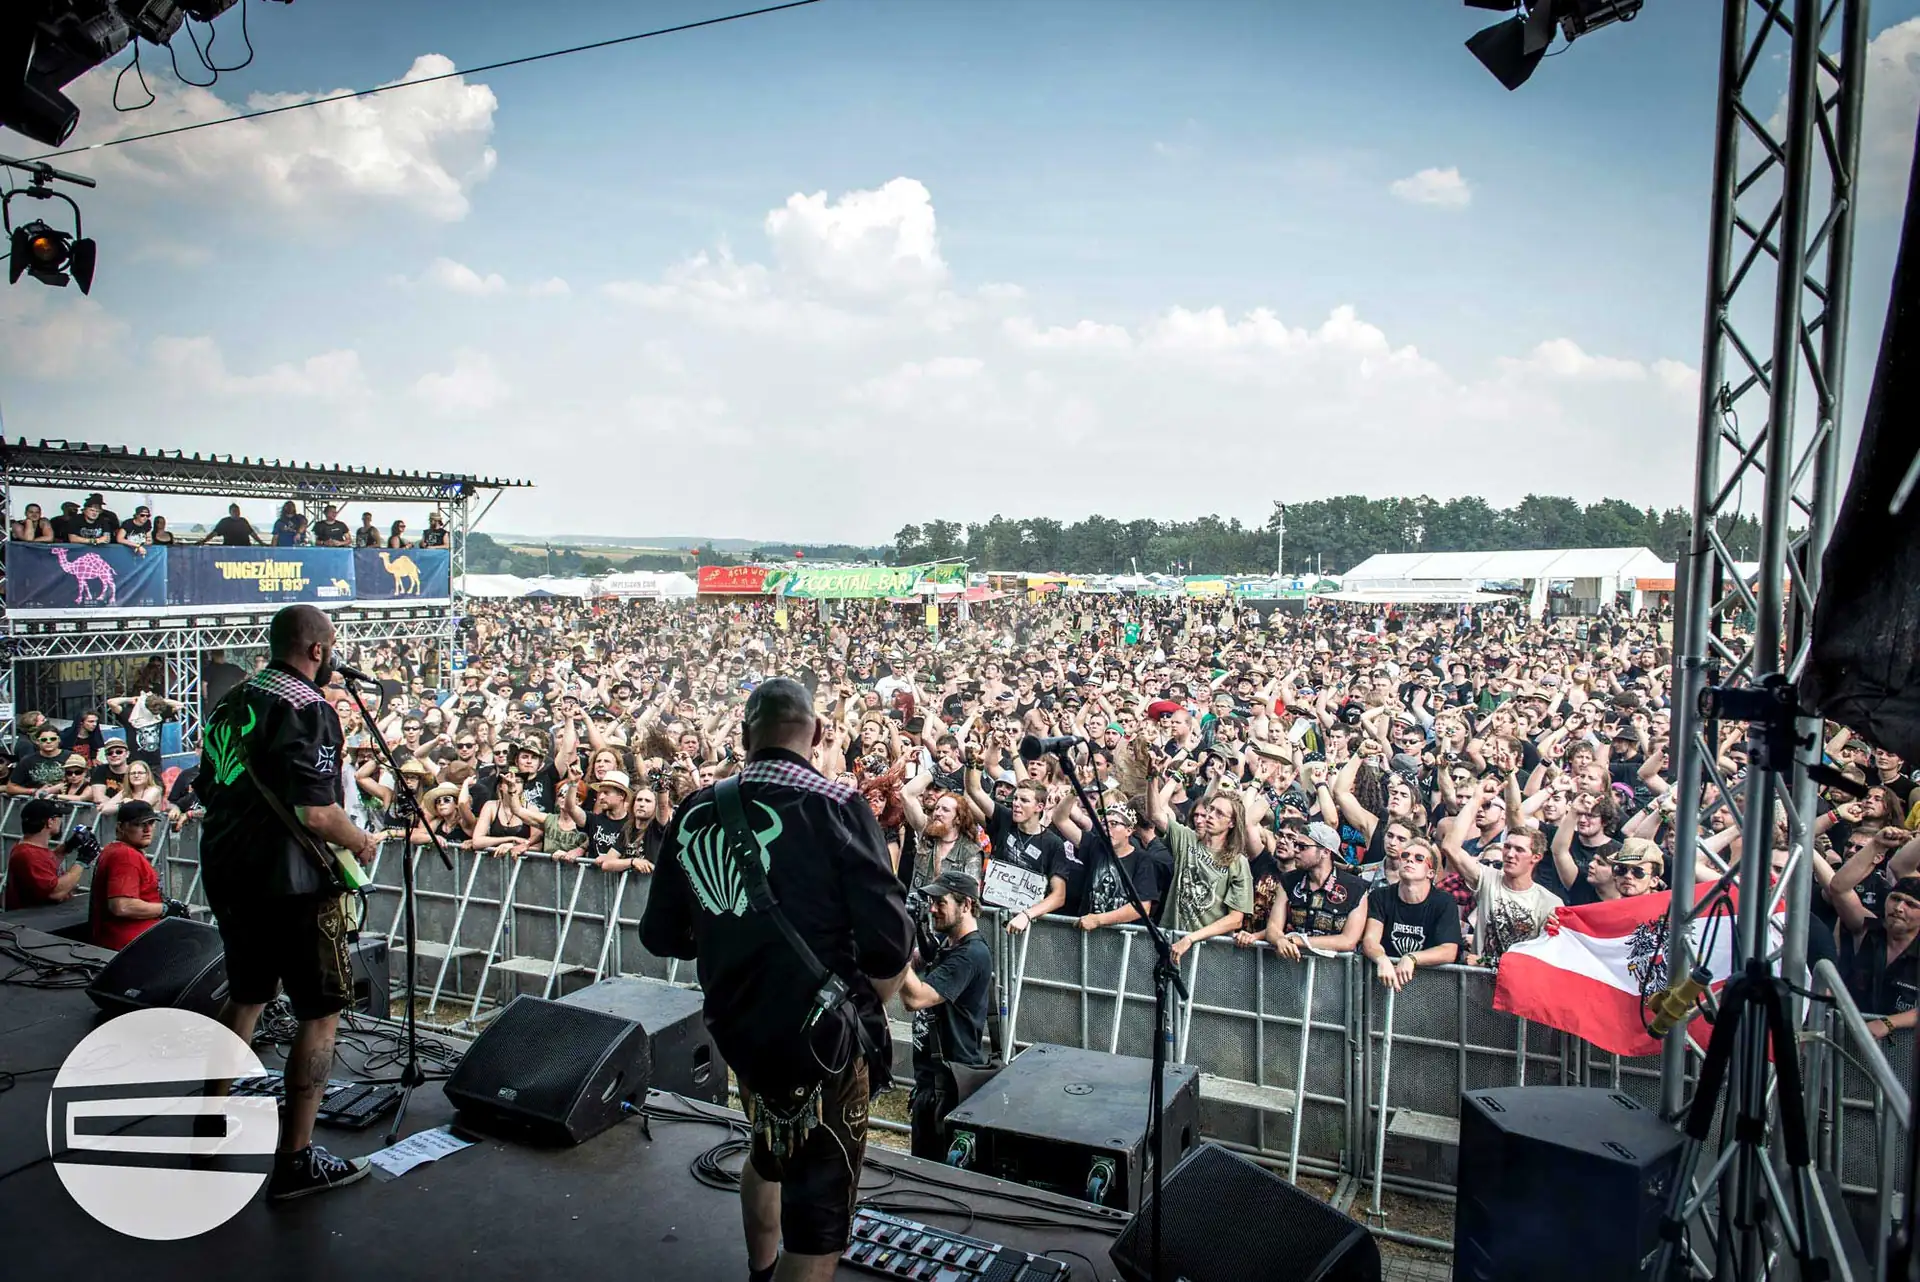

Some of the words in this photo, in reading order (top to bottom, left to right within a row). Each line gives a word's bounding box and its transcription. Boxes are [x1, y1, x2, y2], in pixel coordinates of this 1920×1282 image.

[259, 579, 281, 592] SEIT
[989, 863, 1016, 886] Free
[1019, 871, 1044, 900] Hugs
